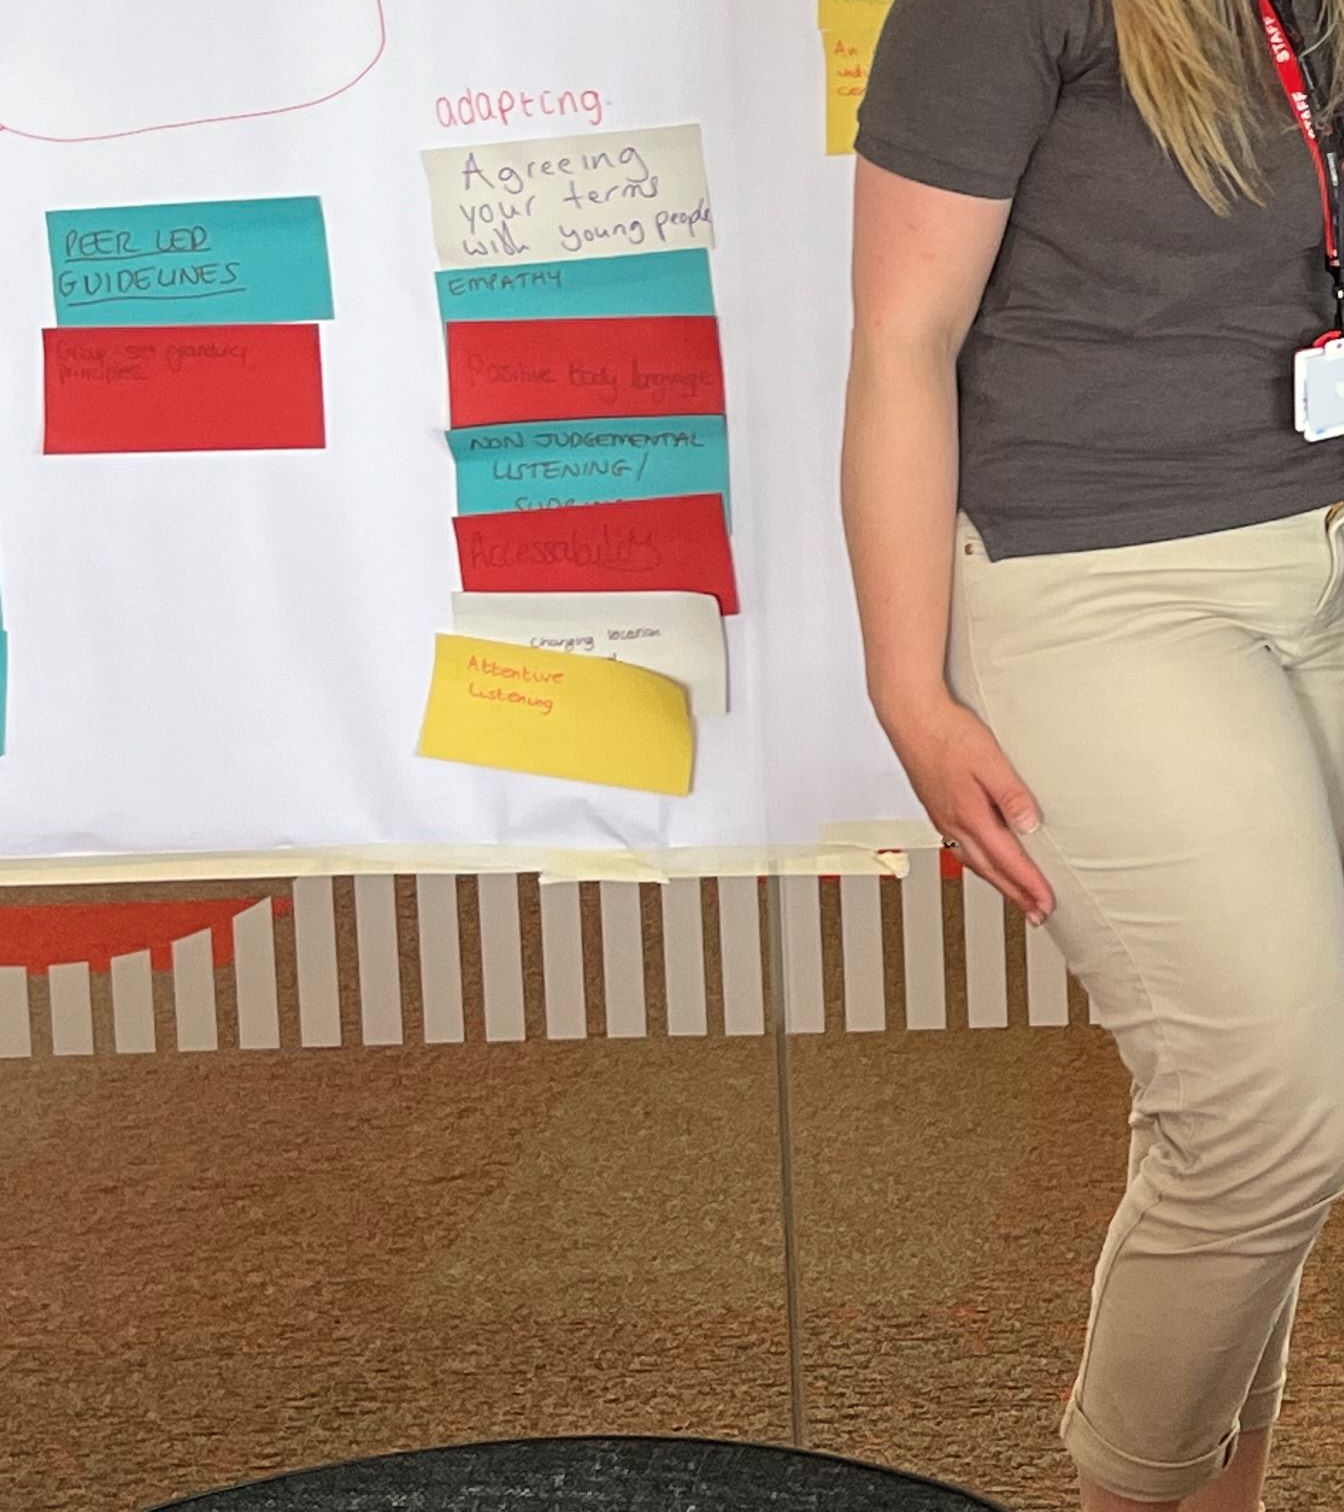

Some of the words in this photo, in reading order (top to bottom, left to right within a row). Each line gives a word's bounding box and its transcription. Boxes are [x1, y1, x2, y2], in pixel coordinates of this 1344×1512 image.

[1262, 16, 1291, 64] STAFF
[436, 88, 603, 128] adapting
[461, 146, 650, 194] Agreeing
[460, 194, 536, 234] your
[563, 176, 659, 209] terms
[65, 229, 139, 257] PEER
[156, 225, 211, 252] LED
[462, 219, 530, 255] with
[558, 220, 645, 251] young
[58, 262, 241, 298] GUIDELINES
[448, 271, 563, 296] EMPATHY
[470, 430, 524, 451] NON
[534, 431, 704, 450] JUDGEMENTAL
